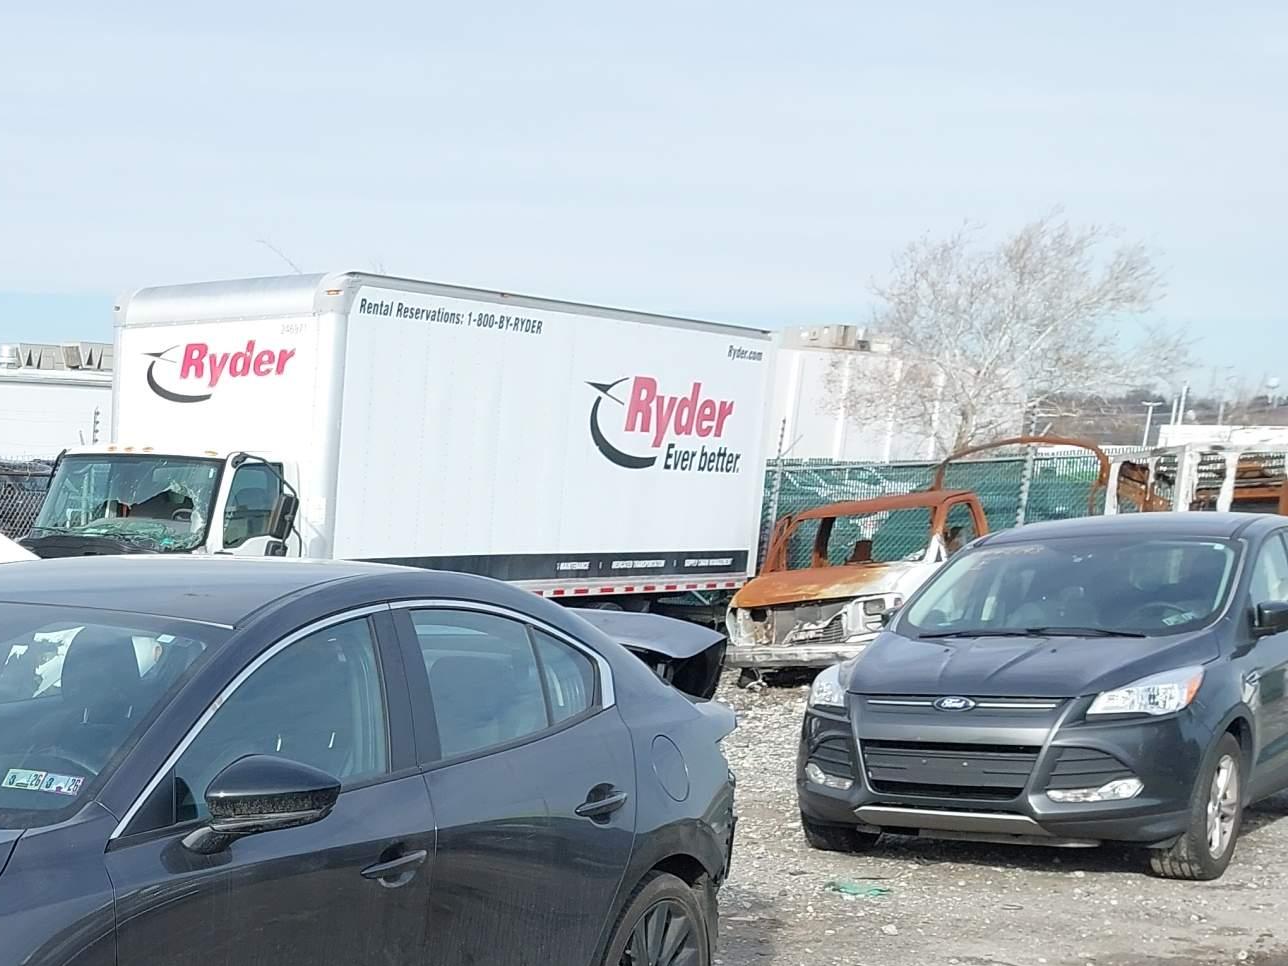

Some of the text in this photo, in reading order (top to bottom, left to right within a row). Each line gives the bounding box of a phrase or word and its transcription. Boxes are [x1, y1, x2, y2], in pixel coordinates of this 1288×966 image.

[359, 298, 543, 335] Rental Reservations: 1-800-BY-RYDER
[179, 339, 297, 388] Ryder
[727, 344, 763, 361] Ryder.com
[624, 376, 734, 448] Ryder
[663, 443, 741, 473] Ever better.
